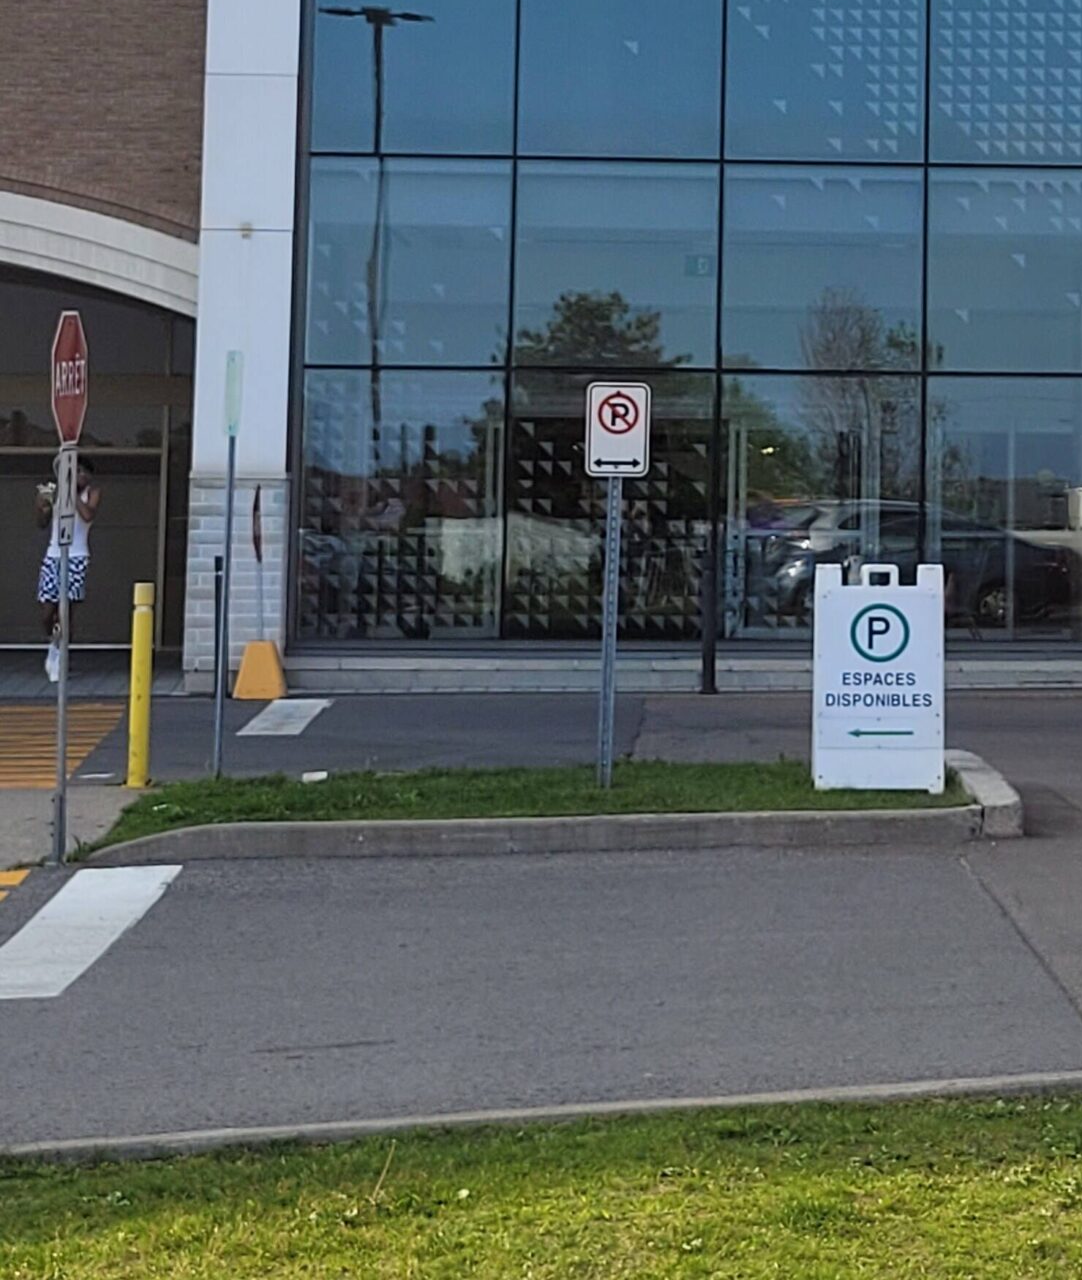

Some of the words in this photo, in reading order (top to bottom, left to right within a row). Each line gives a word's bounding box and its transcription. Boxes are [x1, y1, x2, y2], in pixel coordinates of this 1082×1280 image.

[55, 354, 85, 397] ARRÊT
[867, 616, 890, 650] P
[842, 672, 916, 687] ESPACES
[825, 693, 933, 708] DISPONIBLES
